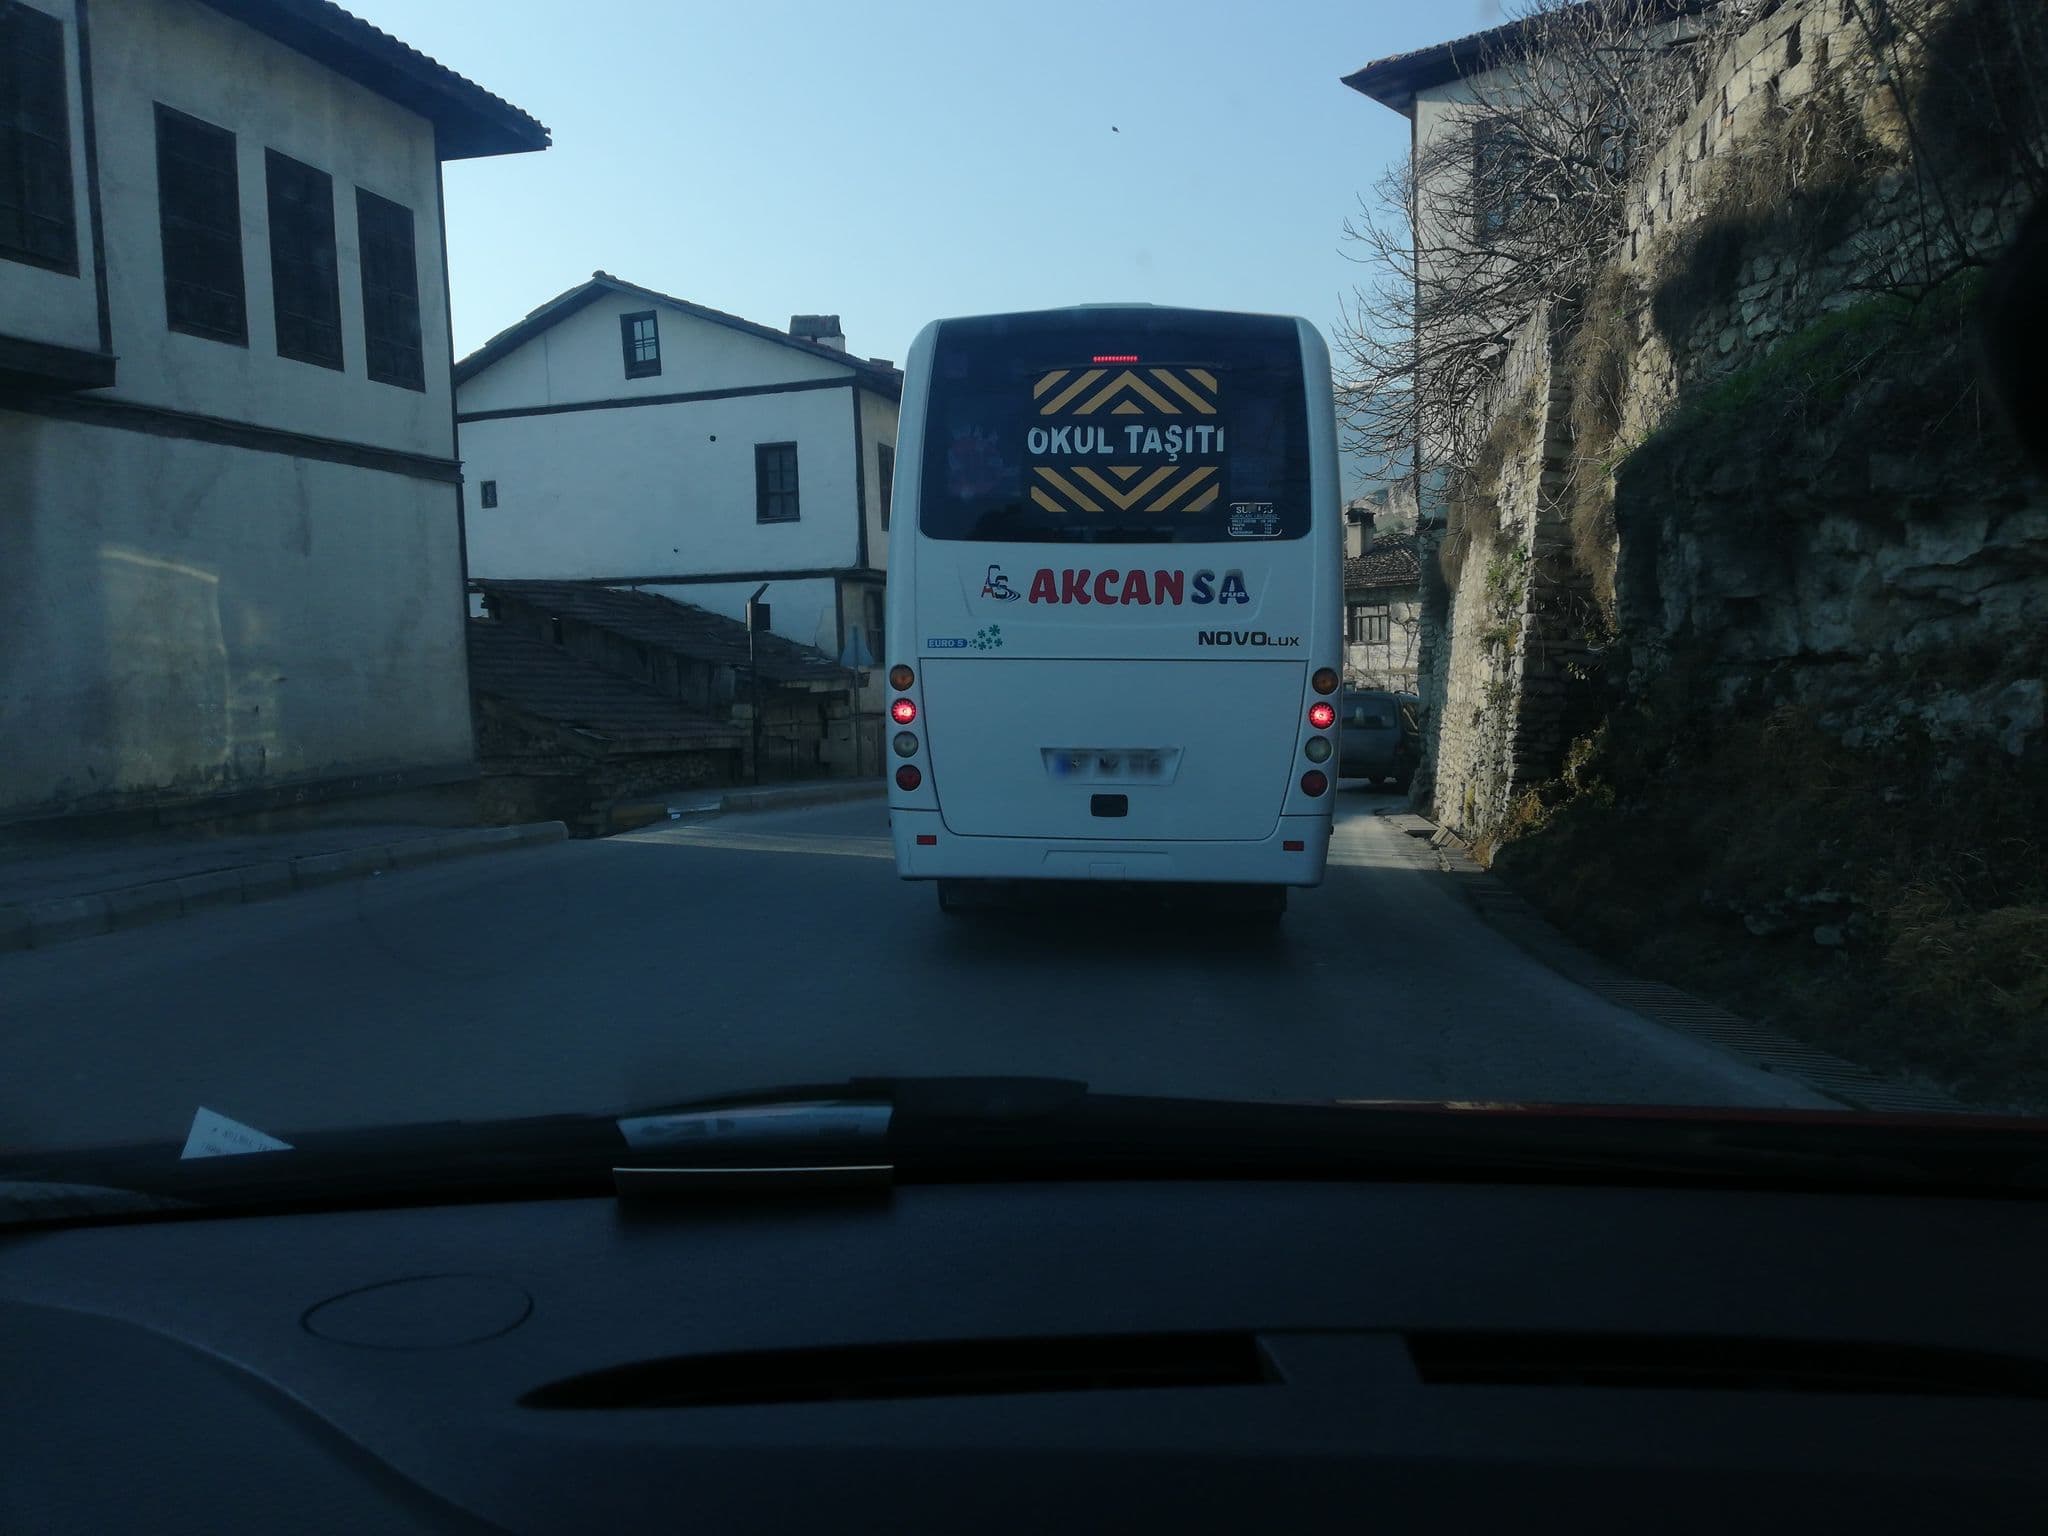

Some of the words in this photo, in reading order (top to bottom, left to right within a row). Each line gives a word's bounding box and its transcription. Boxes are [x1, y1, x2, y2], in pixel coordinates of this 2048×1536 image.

[1027, 425, 1113, 455] OKUL
[1125, 425, 1225, 461] TAŞITI
[928, 639, 955, 648] EURO
